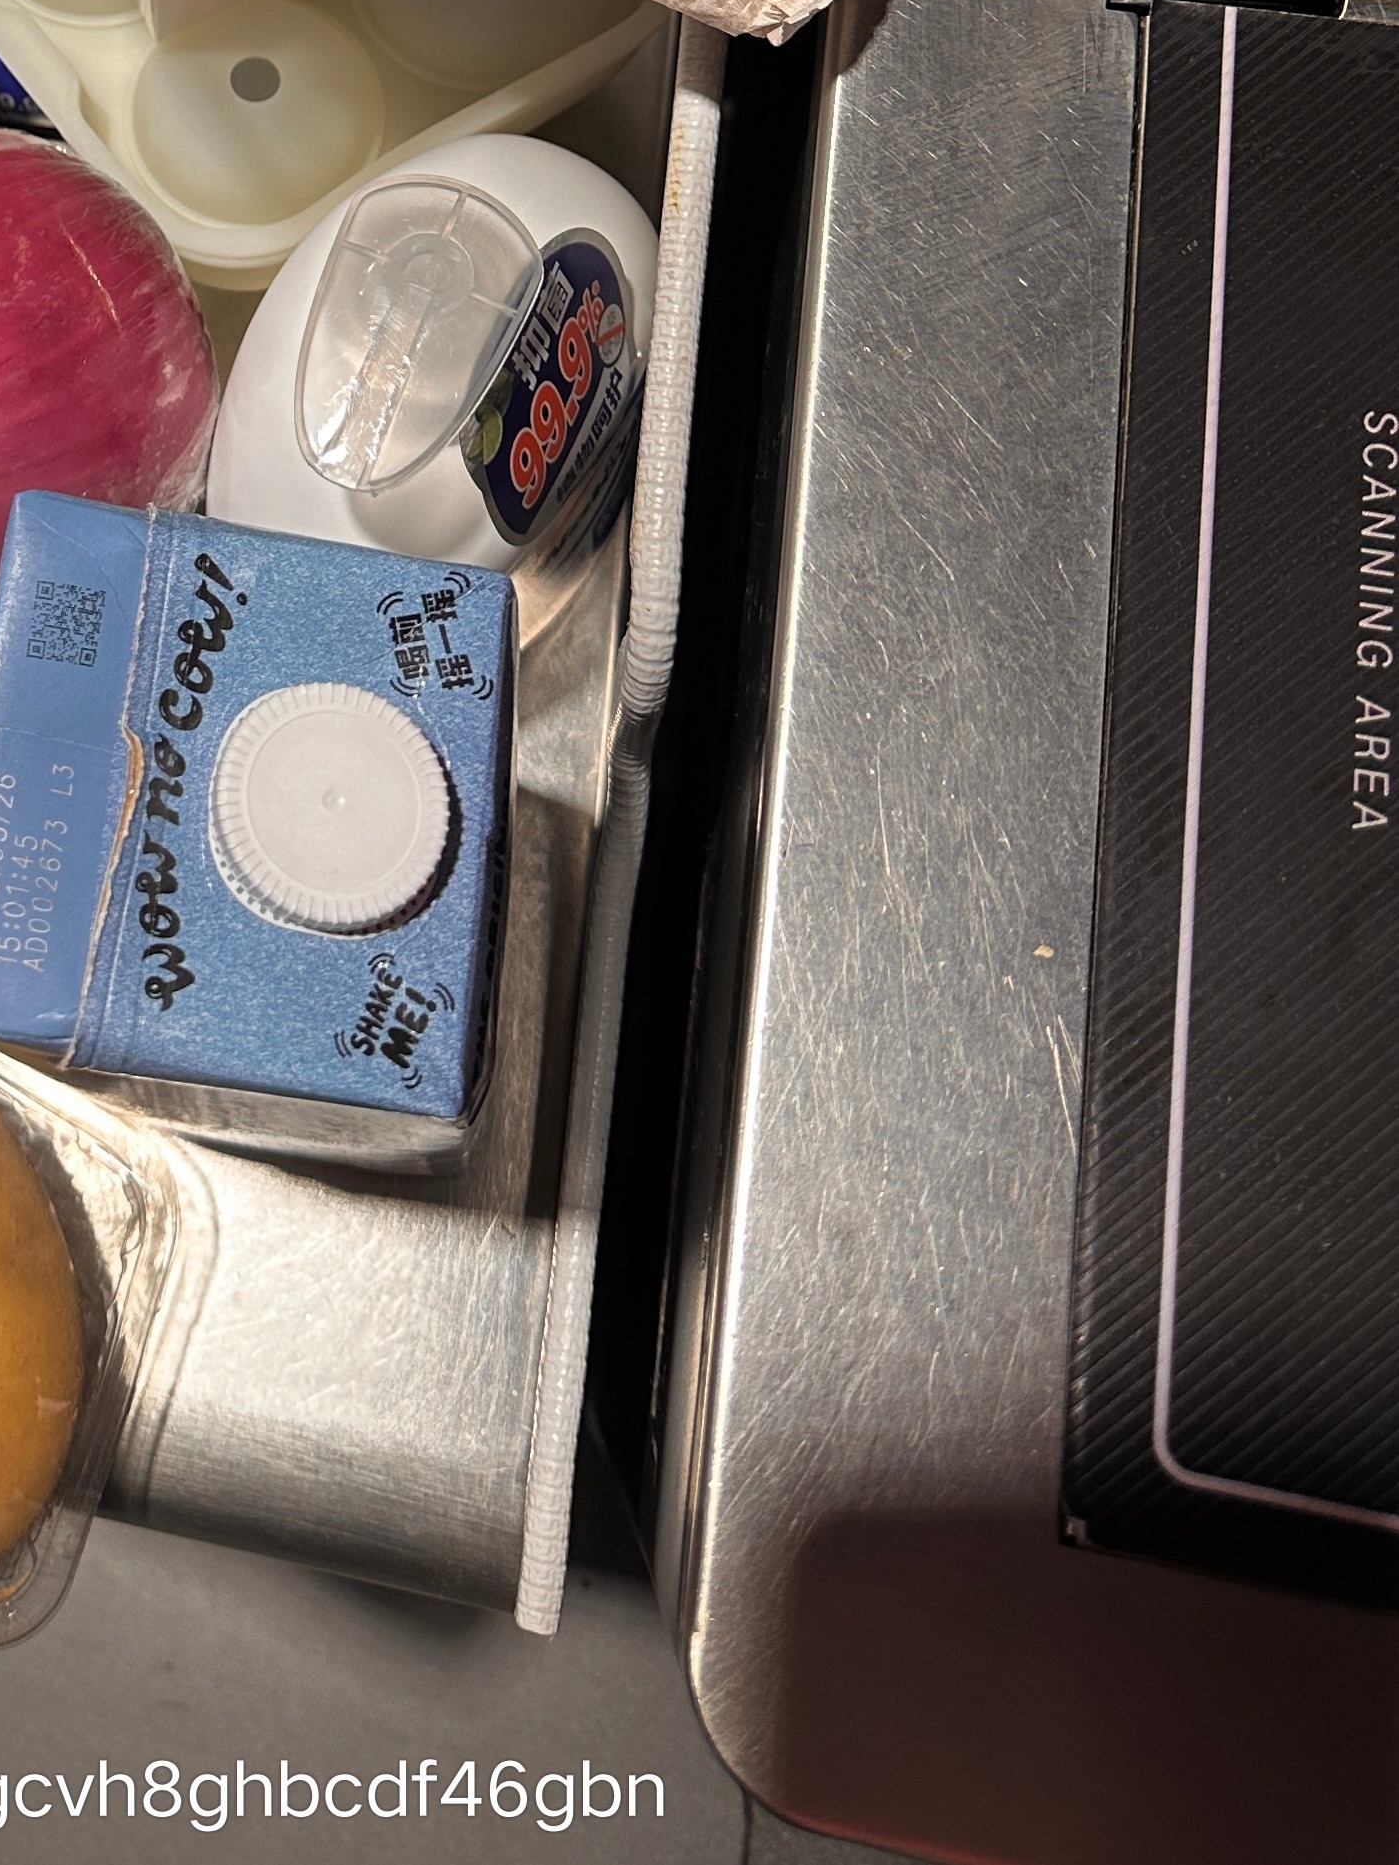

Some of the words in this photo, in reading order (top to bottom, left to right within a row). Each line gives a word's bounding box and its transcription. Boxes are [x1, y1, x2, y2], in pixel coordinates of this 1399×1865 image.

[508, 260, 576, 391] 抑菌
[1355, 410, 1399, 670] SCANNING
[387, 613, 433, 682] 喝前
[420, 587, 475, 692] 摇一摇
[146, 734, 186, 826] no
[1351, 695, 1391, 830] AREA
[21, 819, 69, 973] AD002673
[57, 764, 77, 797] L3
[350, 970, 405, 1056] SHAKE
[379, 988, 439, 1071] ME!
